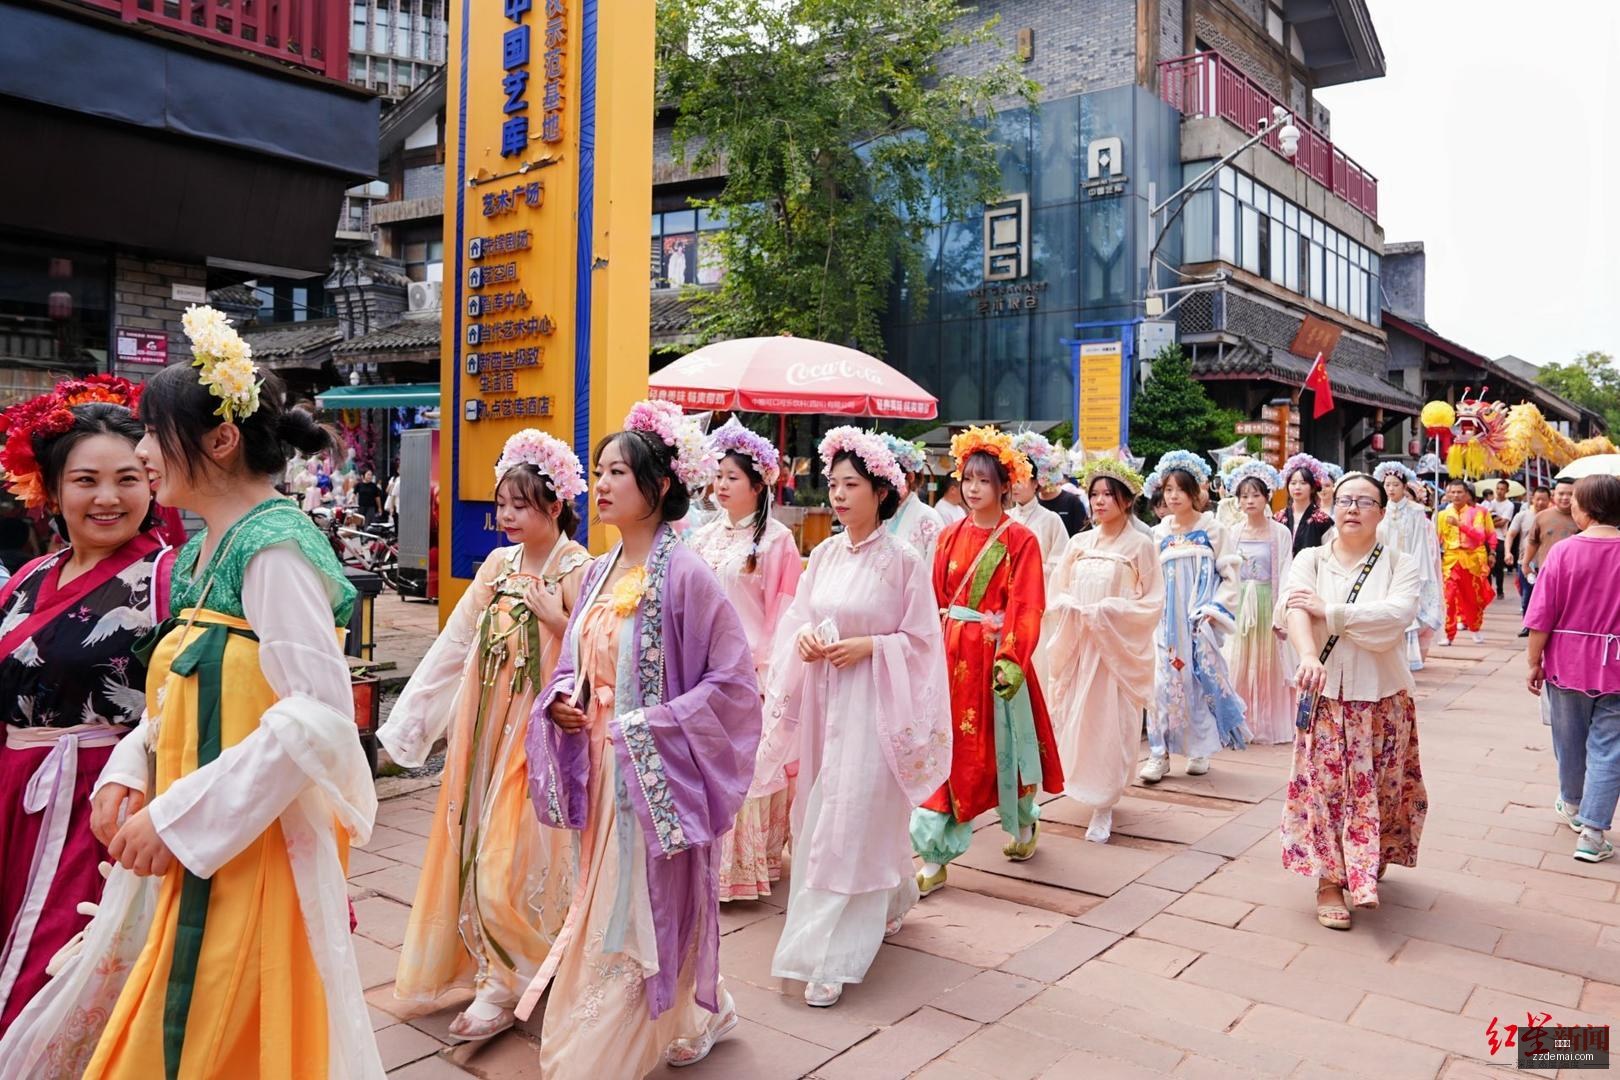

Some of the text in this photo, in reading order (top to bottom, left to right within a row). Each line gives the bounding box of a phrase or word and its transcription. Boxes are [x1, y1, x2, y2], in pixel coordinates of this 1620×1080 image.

[482, 180, 542, 217] 艺术广场
[481, 231, 531, 257] 先锋剧场
[482, 261, 518, 286] 艺空间
[480, 315, 555, 343] 当代艺术中心
[479, 348, 543, 372] 新西兰极致
[480, 371, 518, 394] 生活馆
[479, 396, 553, 419] 九点艺库酒店
